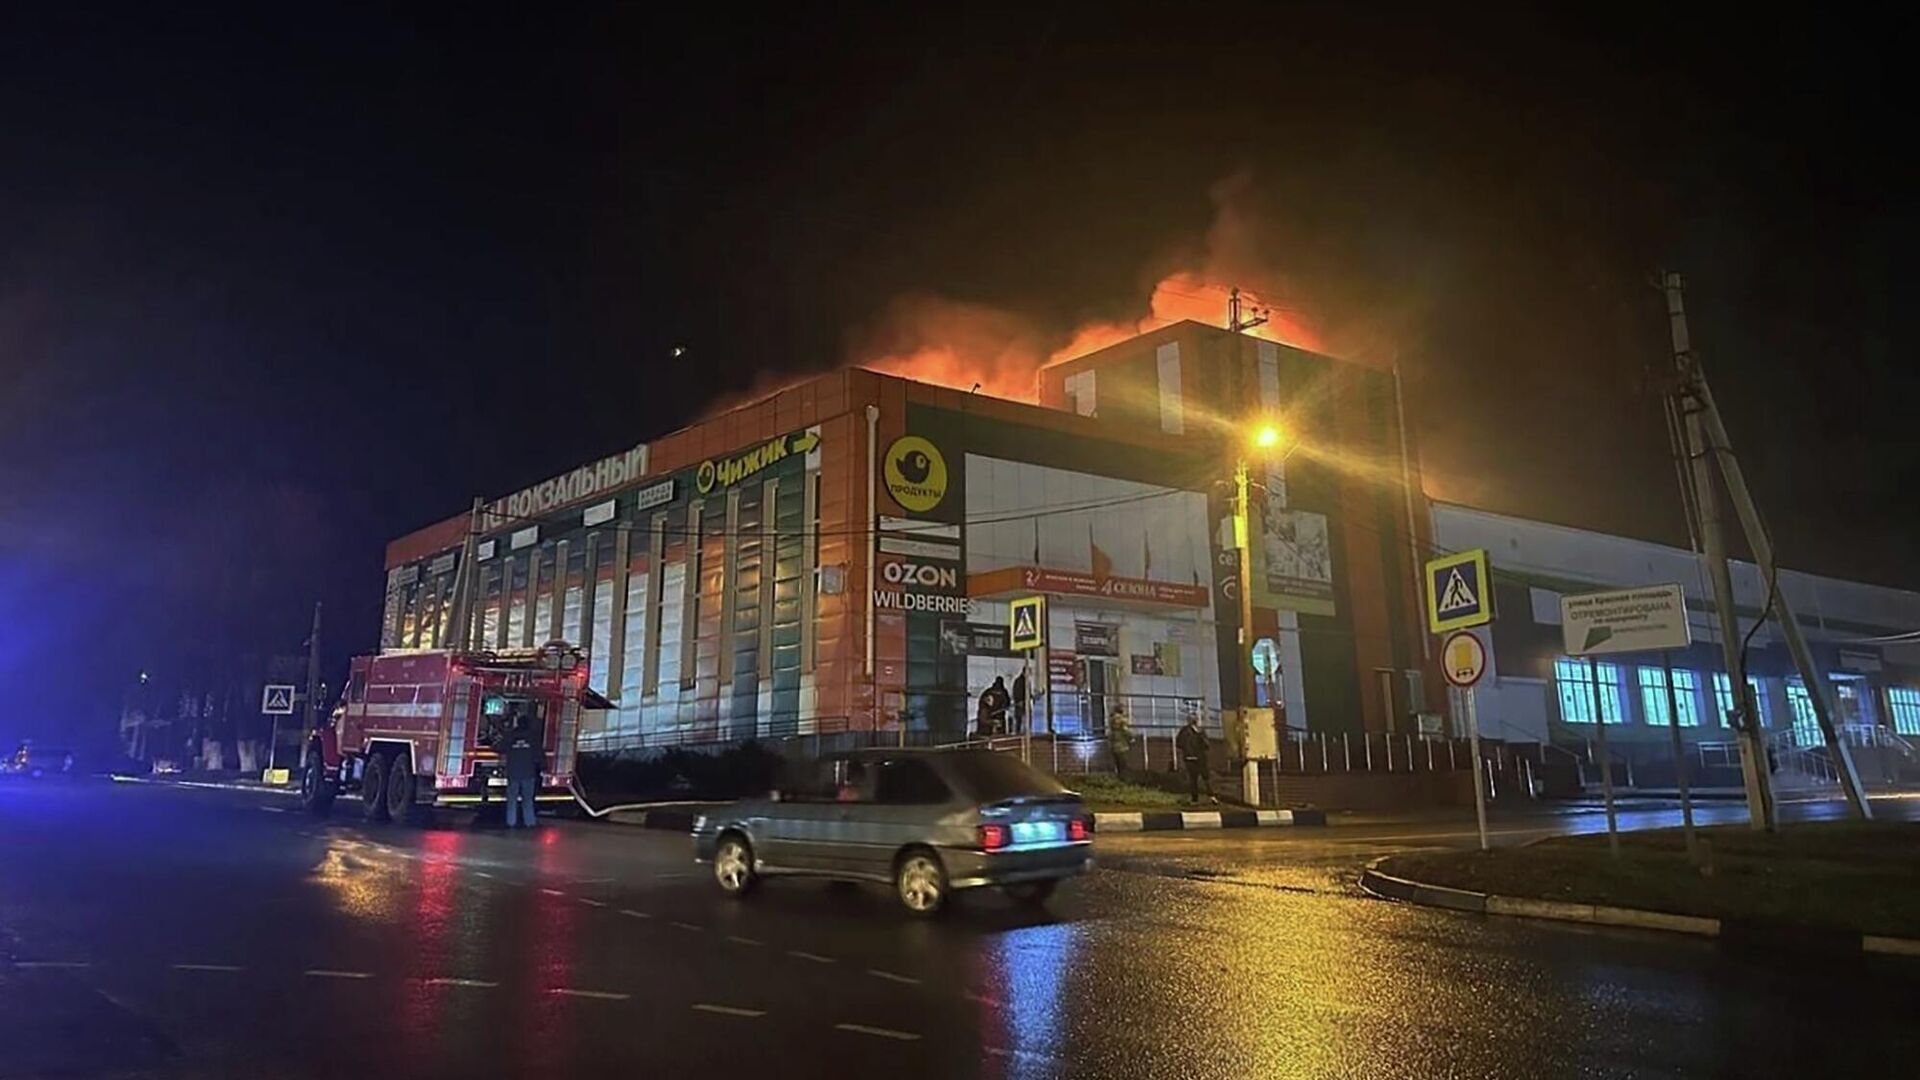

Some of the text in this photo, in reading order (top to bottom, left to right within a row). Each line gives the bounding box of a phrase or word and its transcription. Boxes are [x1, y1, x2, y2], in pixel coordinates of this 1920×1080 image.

[717, 435, 787, 487] Чижик
[508, 443, 648, 521] ВОКЗАЛЬНЫЙ
[890, 483, 942, 498] ПРОДУКТЫ
[884, 561, 957, 588] OZON
[1101, 579, 1112, 596] 4
[874, 589, 976, 614] WILDBERRIES
[1570, 602, 1672, 620] ОТРЕМОНТИРОВАНА
